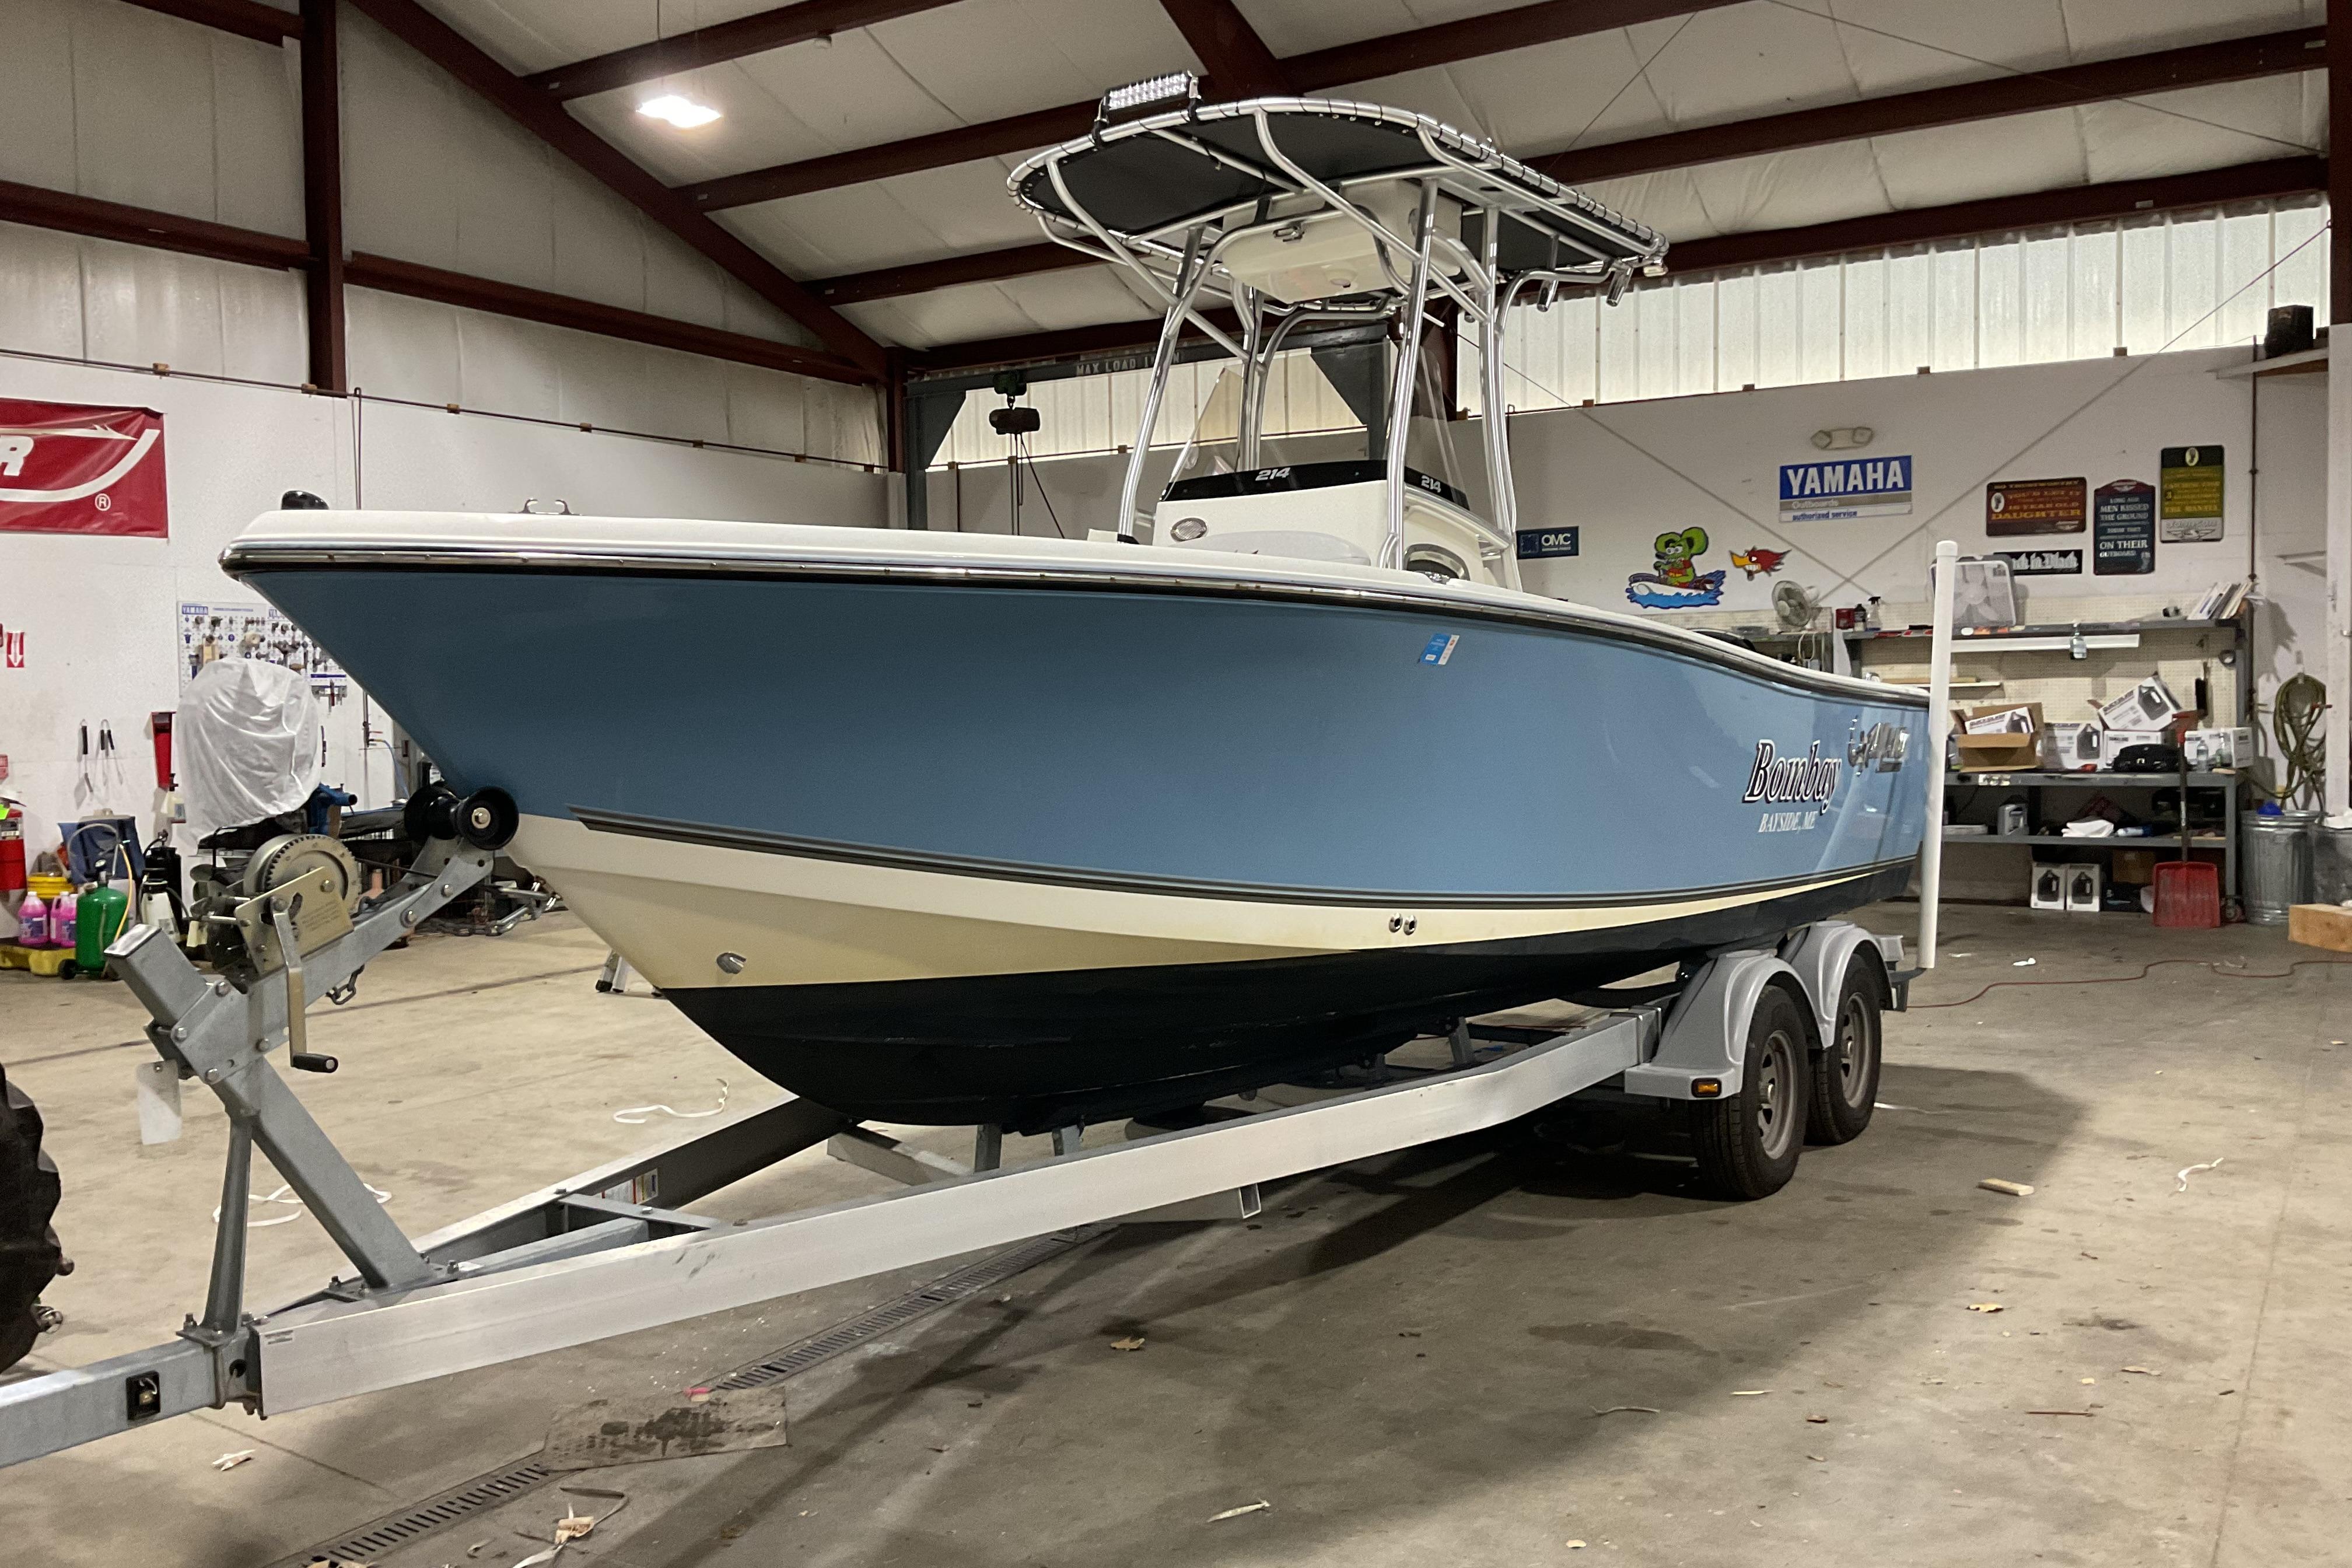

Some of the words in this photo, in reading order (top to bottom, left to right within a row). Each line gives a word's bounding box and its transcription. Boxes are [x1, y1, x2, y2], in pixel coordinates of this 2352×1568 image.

[1076, 362, 1099, 376] MAX
[1105, 358, 1136, 373] LOAD
[1255, 467, 1291, 481] 214
[1787, 460, 1905, 496] YAMAHA
[1421, 474, 1442, 493] 214
[1991, 509, 2082, 520] DAUGHTER
[2100, 505, 2119, 513] MEN
[2120, 503, 2150, 512] KISSED
[1792, 511, 1830, 522] authorized
[1831, 510, 1858, 519] service
[2116, 512, 2148, 520] GROUND
[1541, 533, 1572, 547] OMC
[2099, 541, 2115, 550] ON
[2117, 539, 2148, 550] THEIR
[1742, 738, 1842, 816] Bombay
[1758, 813, 1801, 834] BAYSIDE,
[1801, 811, 1819, 830] ME
